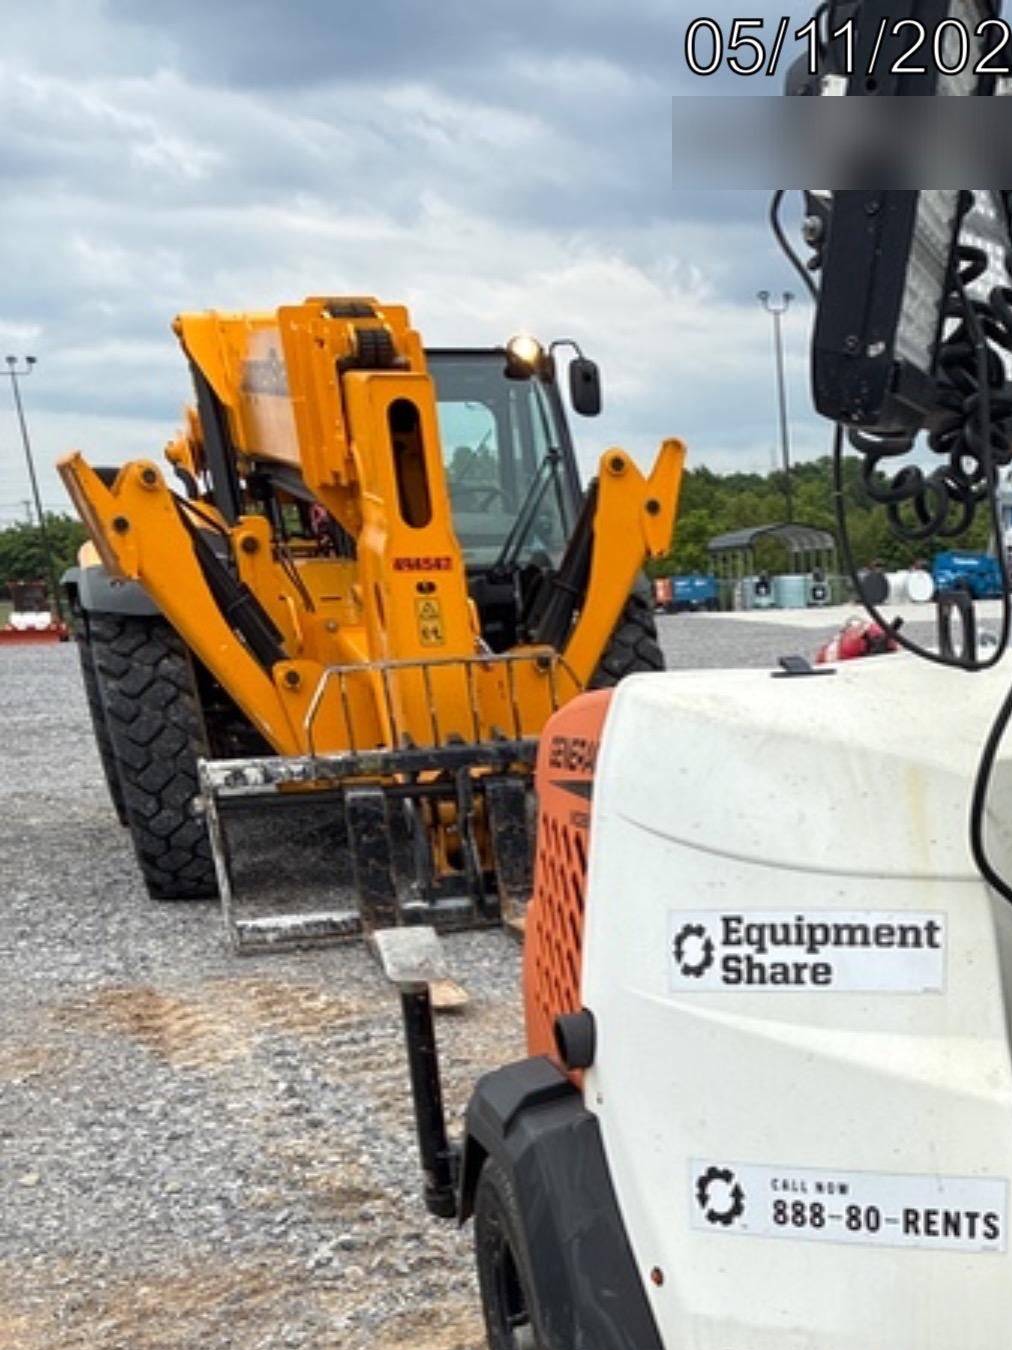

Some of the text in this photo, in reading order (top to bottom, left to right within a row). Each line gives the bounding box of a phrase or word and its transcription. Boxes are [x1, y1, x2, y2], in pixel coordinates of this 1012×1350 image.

[721, 914, 941, 955] Equipment
[721, 953, 833, 986] Share
[770, 1177, 849, 1195] CALL NOW
[772, 1199, 1000, 1240] 888-80-RENTS
